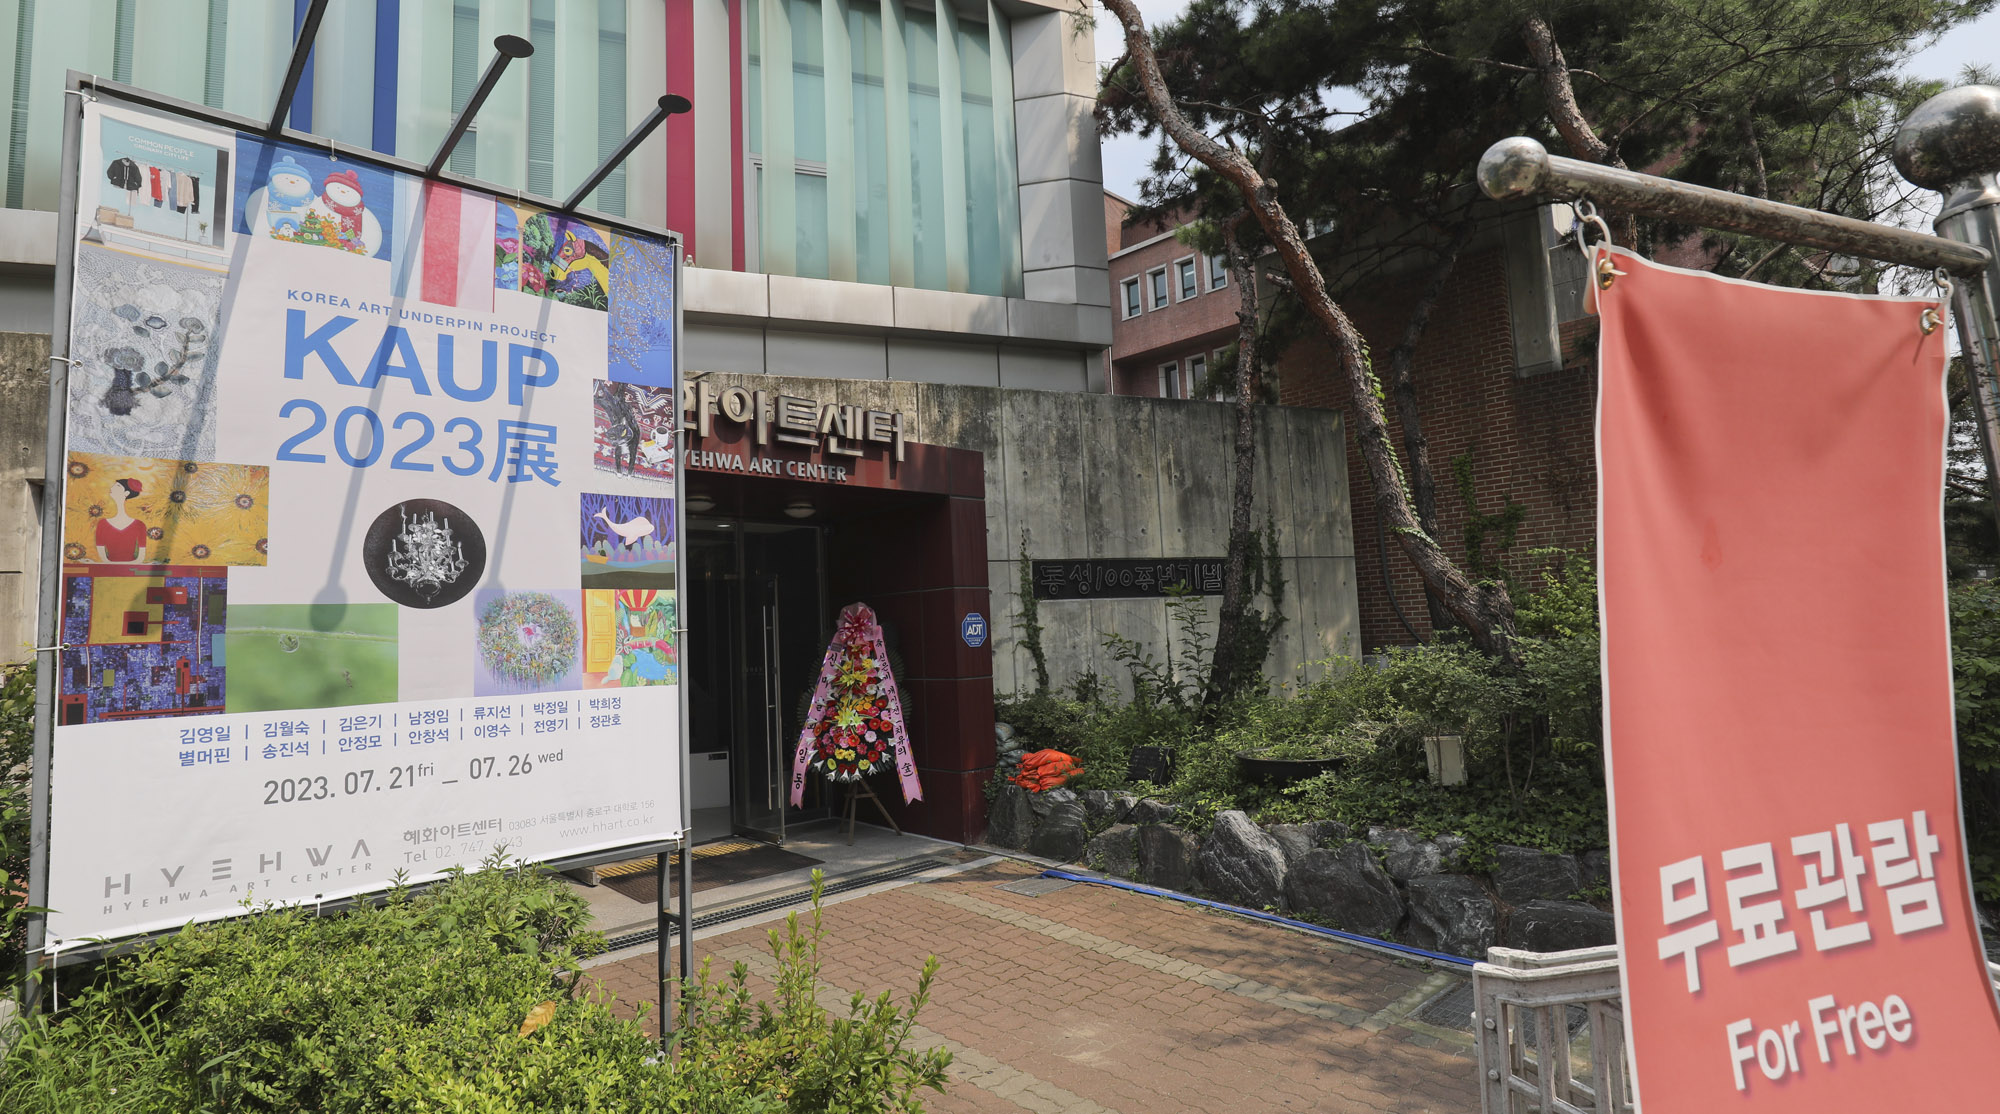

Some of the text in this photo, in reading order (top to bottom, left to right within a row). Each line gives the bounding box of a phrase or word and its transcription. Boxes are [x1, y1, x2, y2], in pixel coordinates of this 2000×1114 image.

[128, 135, 195, 158] COMMON PEOPLE
[287, 289, 557, 344] KOREA ART UNDERPIN PROJECT
[283, 308, 560, 406] KAUP
[276, 398, 562, 488] 2023展
[749, 457, 781, 475] ART
[786, 460, 847, 482] CENTER
[1040, 563, 1225, 595] 동성100주년기념
[966, 624, 982, 636] ADT
[179, 714, 622, 767] 별머핀 송진석 안정모 안창석 이영수 전영기 정관호
[180, 696, 622, 745] 김영일 김월숙 김은기 남정임 류지선 박정일 박희정
[263, 776, 336, 806] 2023.
[344, 769, 382, 796] 07.
[470, 756, 501, 780] 07.
[508, 753, 533, 776] 26
[538, 749, 564, 763] wed
[403, 800, 655, 845] 혜화아트센터 03083 서울특별시 종로구 대학로 156
[560, 814, 655, 839] www.hhart.co.kr
[404, 850, 427, 864] Tel
[435, 845, 456, 859] 02.
[461, 840, 488, 855] 747.
[104, 862, 373, 915] HYEHWA ART CENTER
[1657, 809, 1943, 993] 무료관람
[1726, 994, 1912, 1091] For Free
